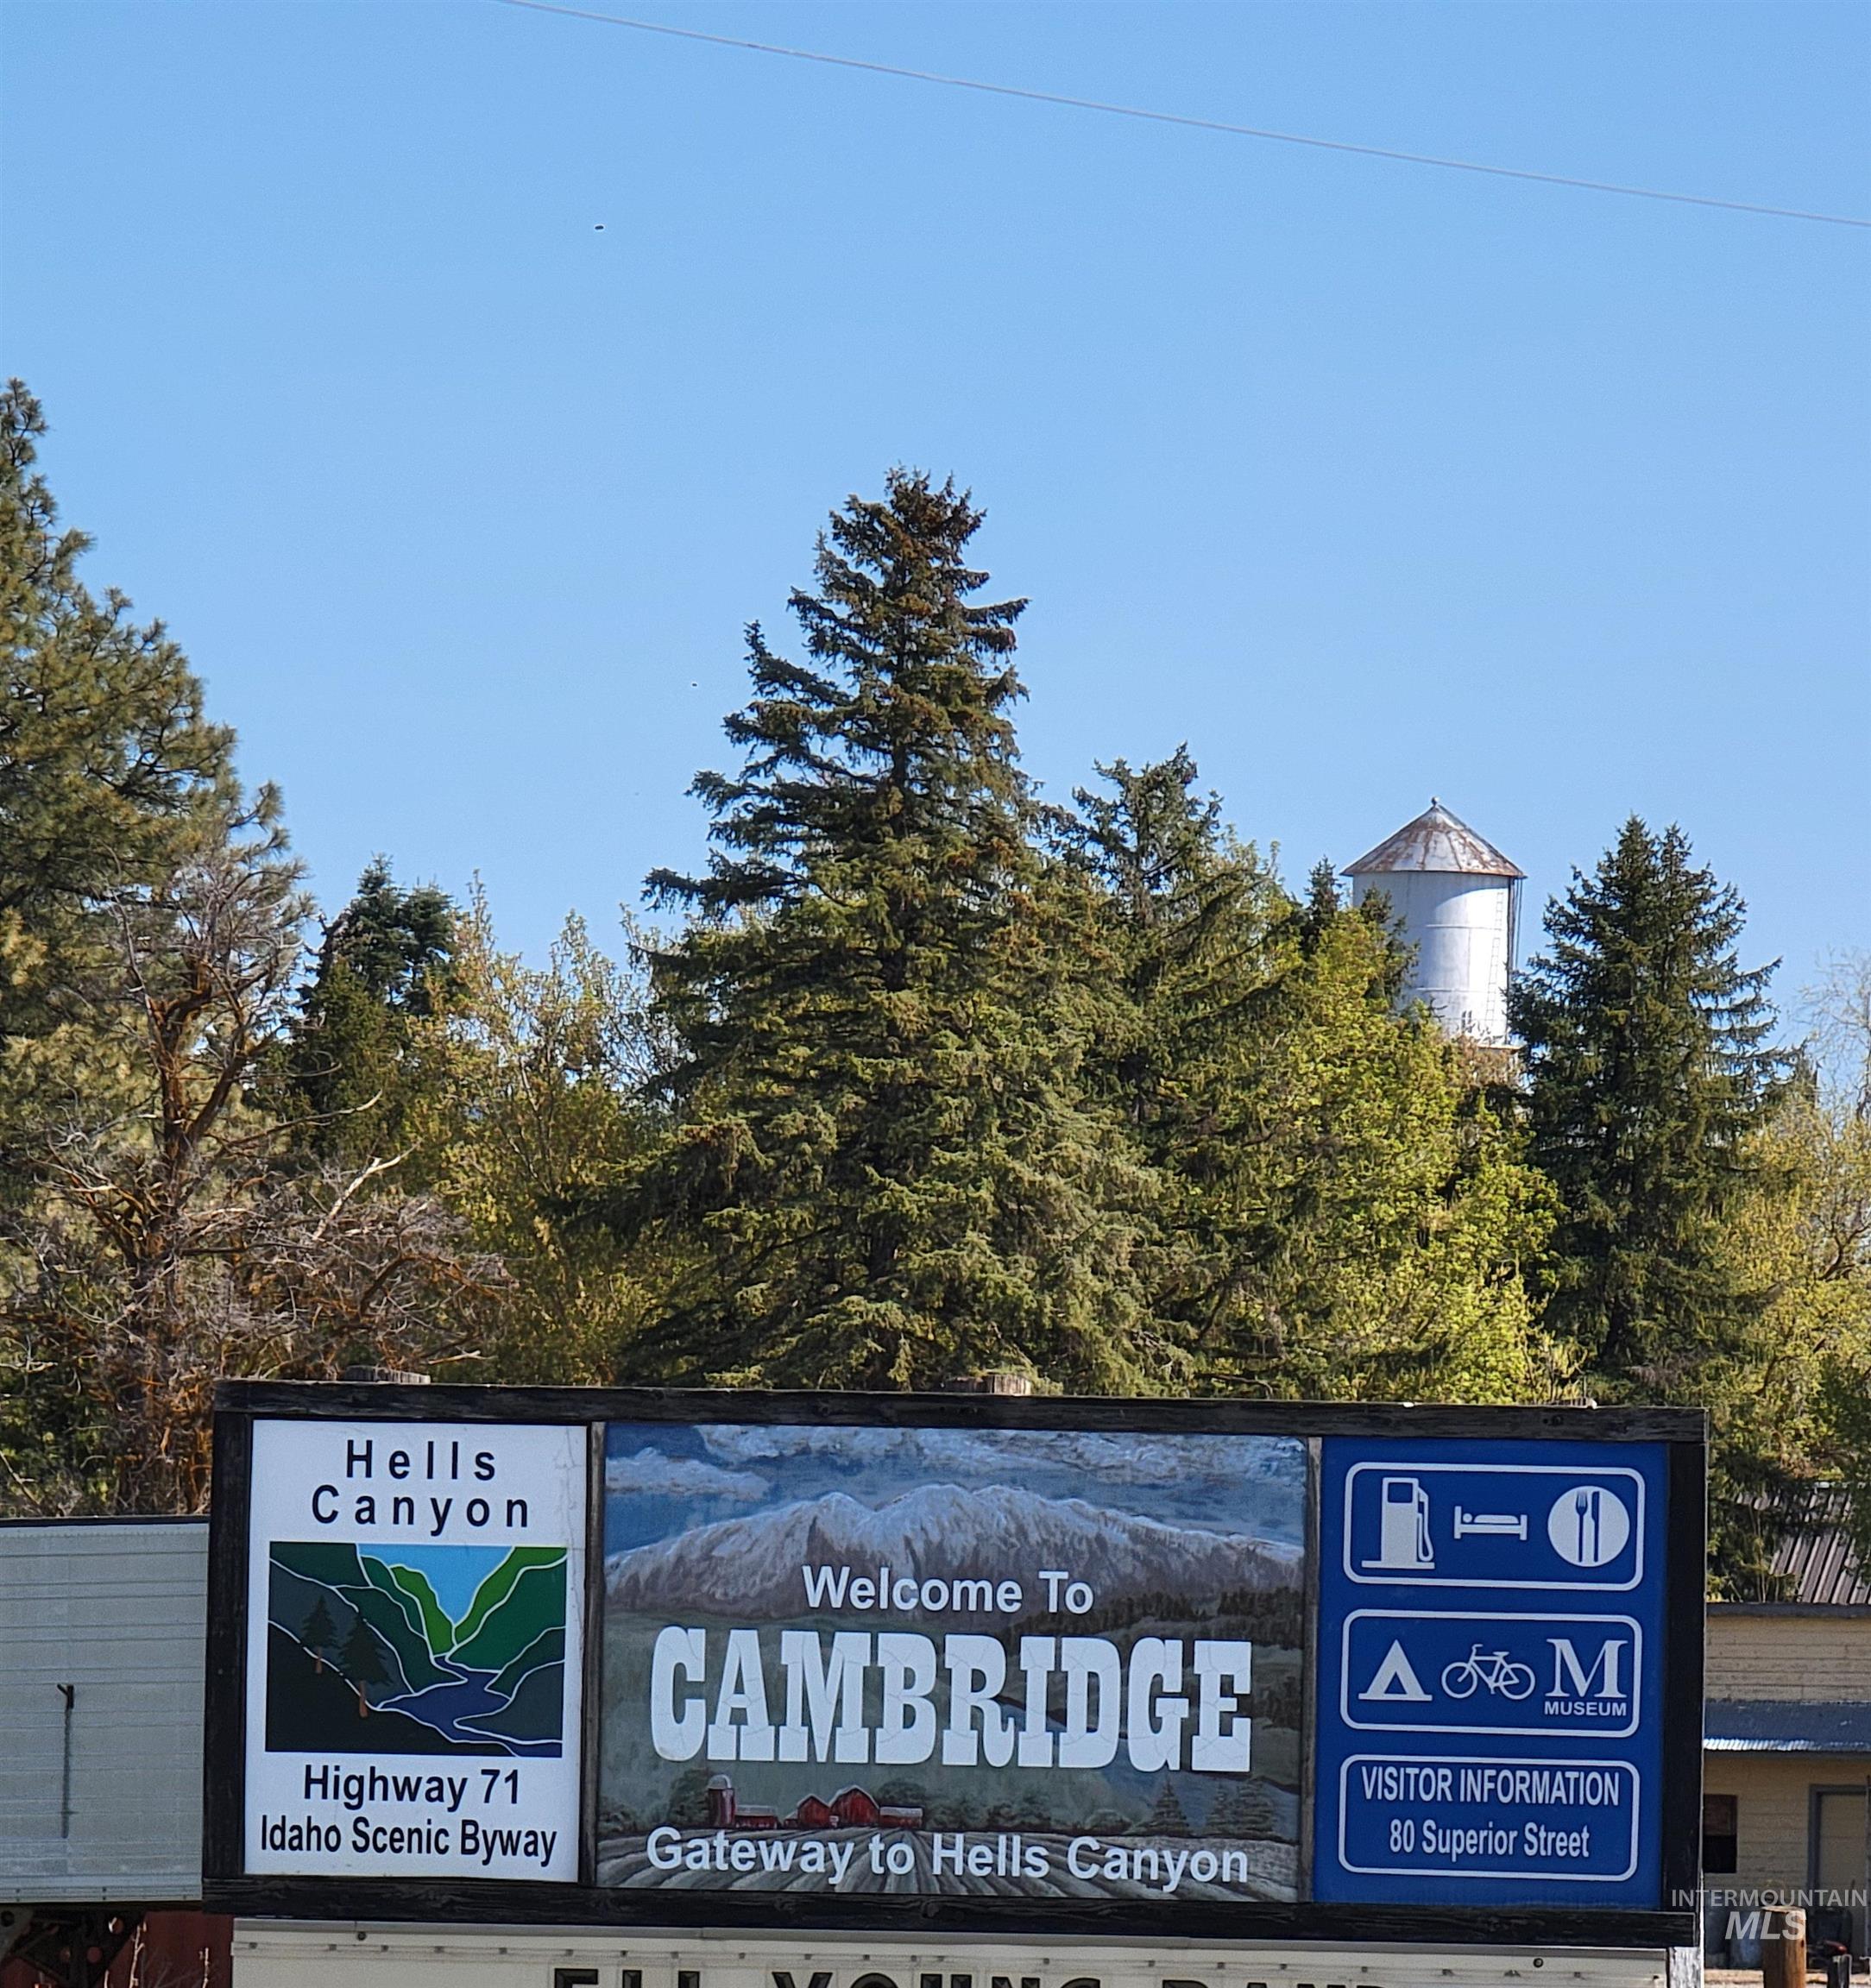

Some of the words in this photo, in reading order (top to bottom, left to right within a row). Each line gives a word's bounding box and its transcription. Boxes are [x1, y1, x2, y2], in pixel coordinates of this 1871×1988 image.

[346, 1439, 496, 1481] Hells
[312, 1485, 528, 1536] Canyon
[803, 1565, 1023, 1613] Welcome
[1039, 1570, 1095, 1615] To
[650, 1626, 1252, 1773] CAMBRIDGE
[1544, 1702, 1628, 1717] MUSEUM
[304, 1765, 468, 1811] Highway
[481, 1769, 520, 1804] 71
[1361, 1765, 1453, 1802] VISITOR
[1459, 1769, 1620, 1806] INFORMATION
[261, 1815, 342, 1853] Idaho
[351, 1816, 450, 1856] Scenic
[461, 1819, 557, 1867] Byway
[646, 1826, 854, 1885] Gateway
[870, 1836, 915, 1876] to
[932, 1833, 1049, 1878] Hells
[1067, 1835, 1249, 1893] Canyon
[1389, 1818, 1415, 1853] 80
[1422, 1820, 1518, 1862] Superior
[1524, 1821, 1590, 1858] Street
